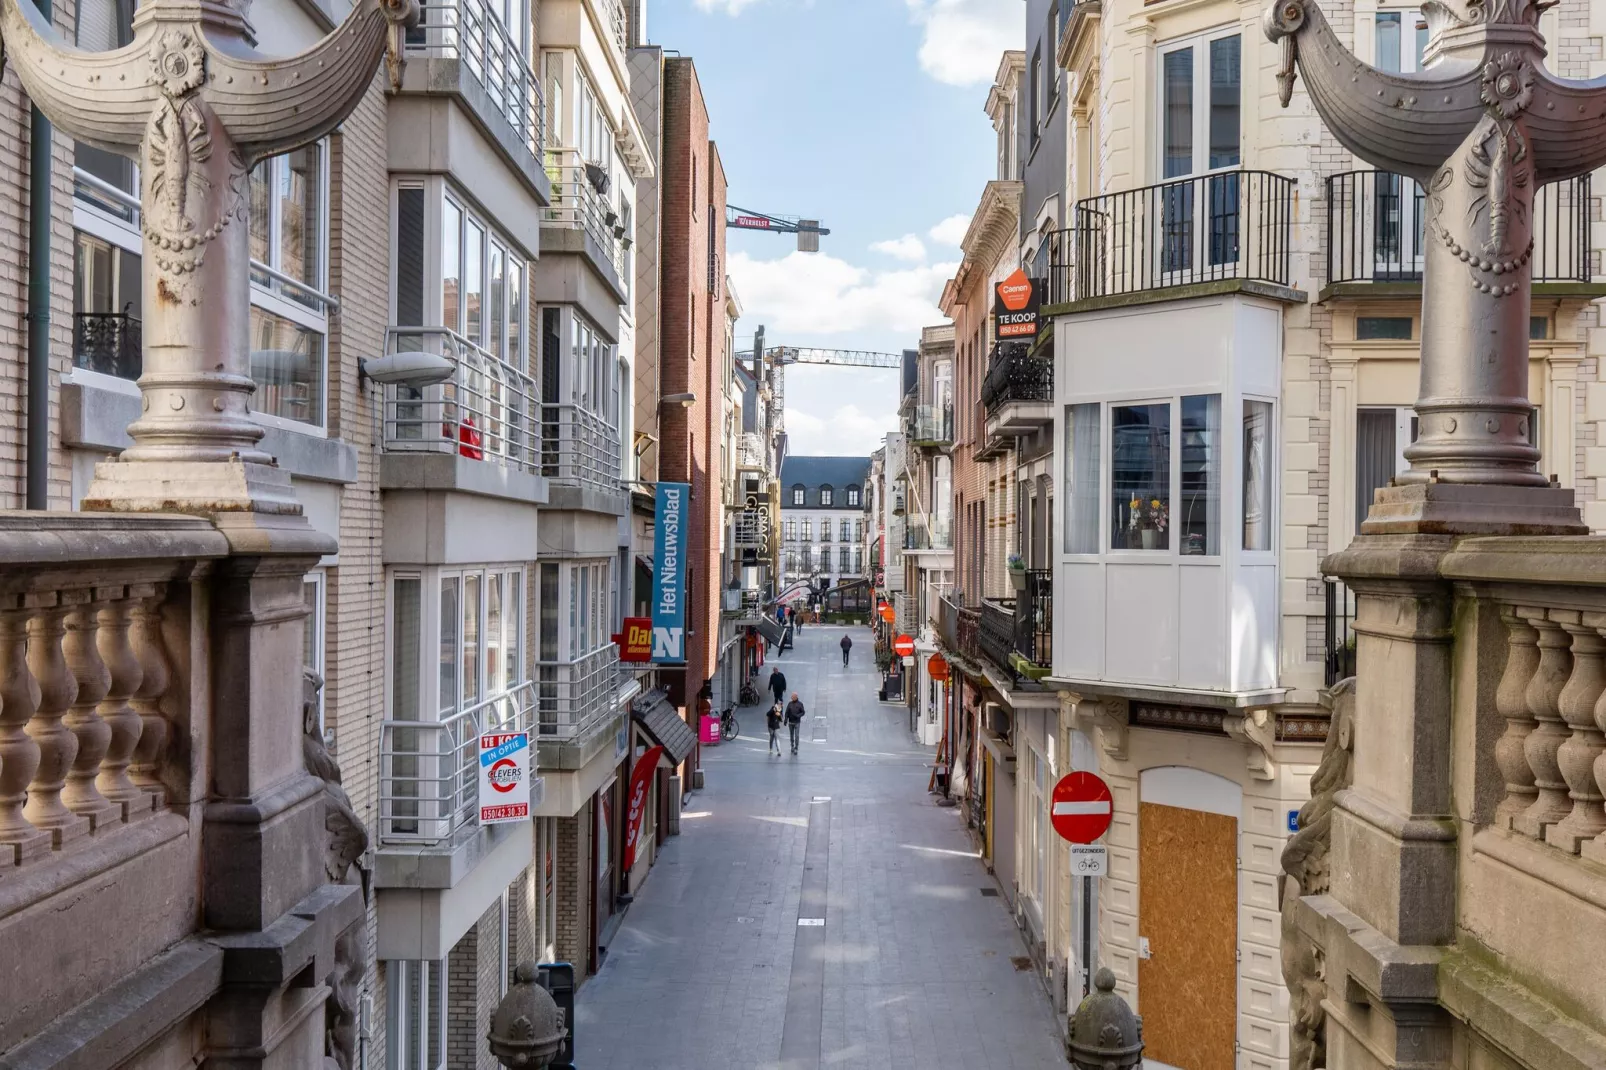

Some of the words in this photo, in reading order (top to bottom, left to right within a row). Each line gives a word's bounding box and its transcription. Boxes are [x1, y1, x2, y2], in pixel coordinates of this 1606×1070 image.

[999, 314, 1010, 324] TE
[1011, 313, 1036, 323] KOOP
[1000, 326, 1011, 334] 050
[661, 488, 680, 584] Nieuwsblad
[659, 586, 676, 614] Het
[652, 627, 683, 658] N
[483, 736, 495, 748] TE
[487, 751, 497, 761] IN
[498, 739, 520, 756] OPTIE
[487, 768, 522, 779] CLEVERS
